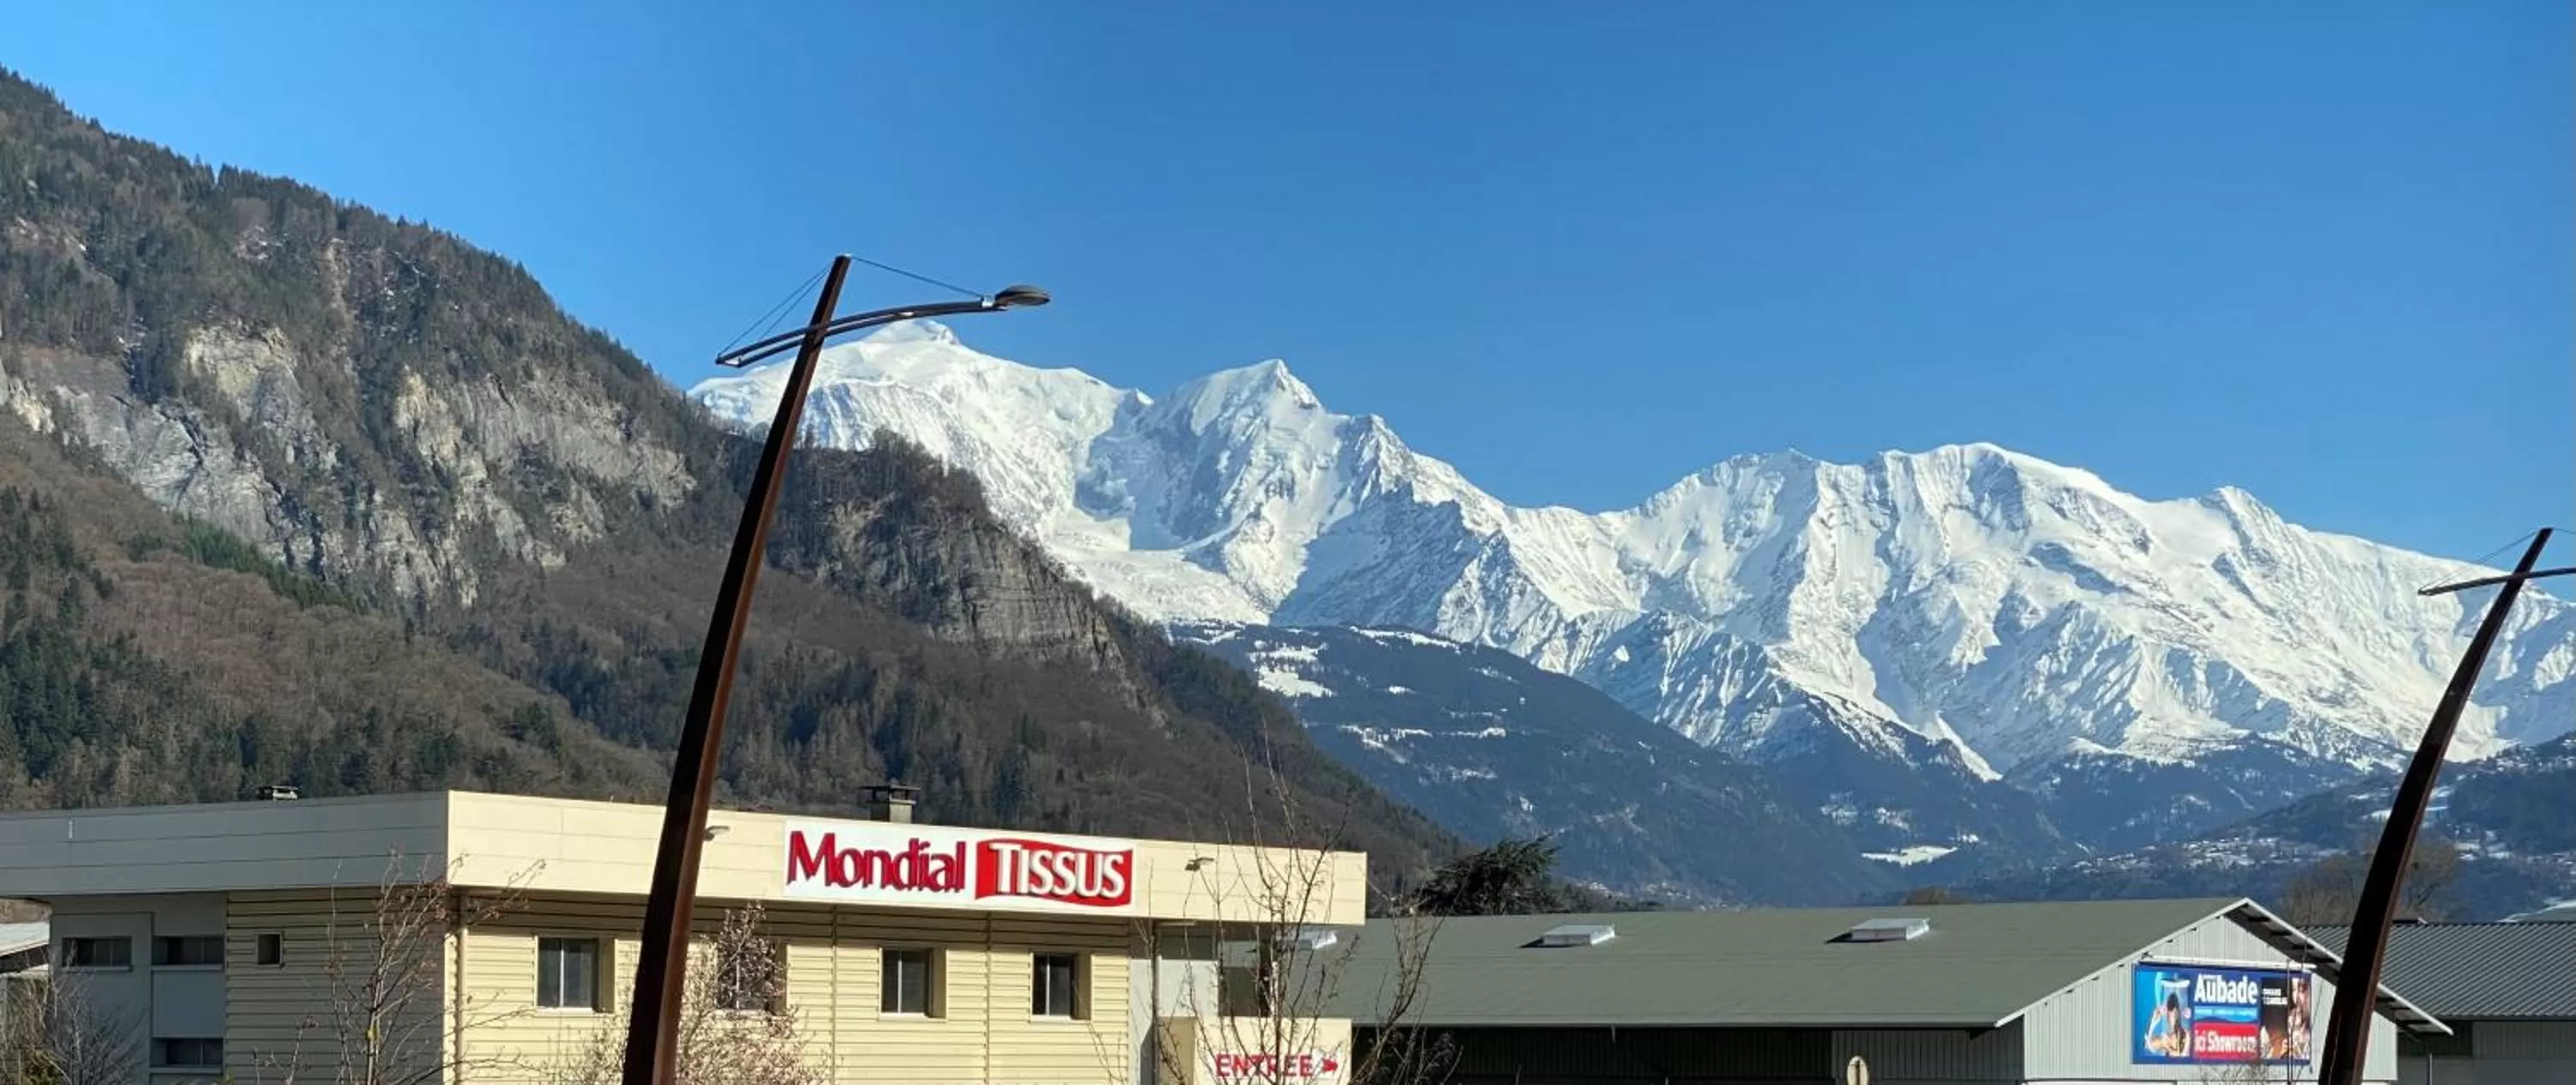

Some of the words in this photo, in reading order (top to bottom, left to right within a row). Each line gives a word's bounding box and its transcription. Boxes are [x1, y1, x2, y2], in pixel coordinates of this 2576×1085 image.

[787, 830, 966, 893] Mondial
[989, 842, 1125, 898] TISSUS
[2194, 974, 2258, 1003] Aubade
